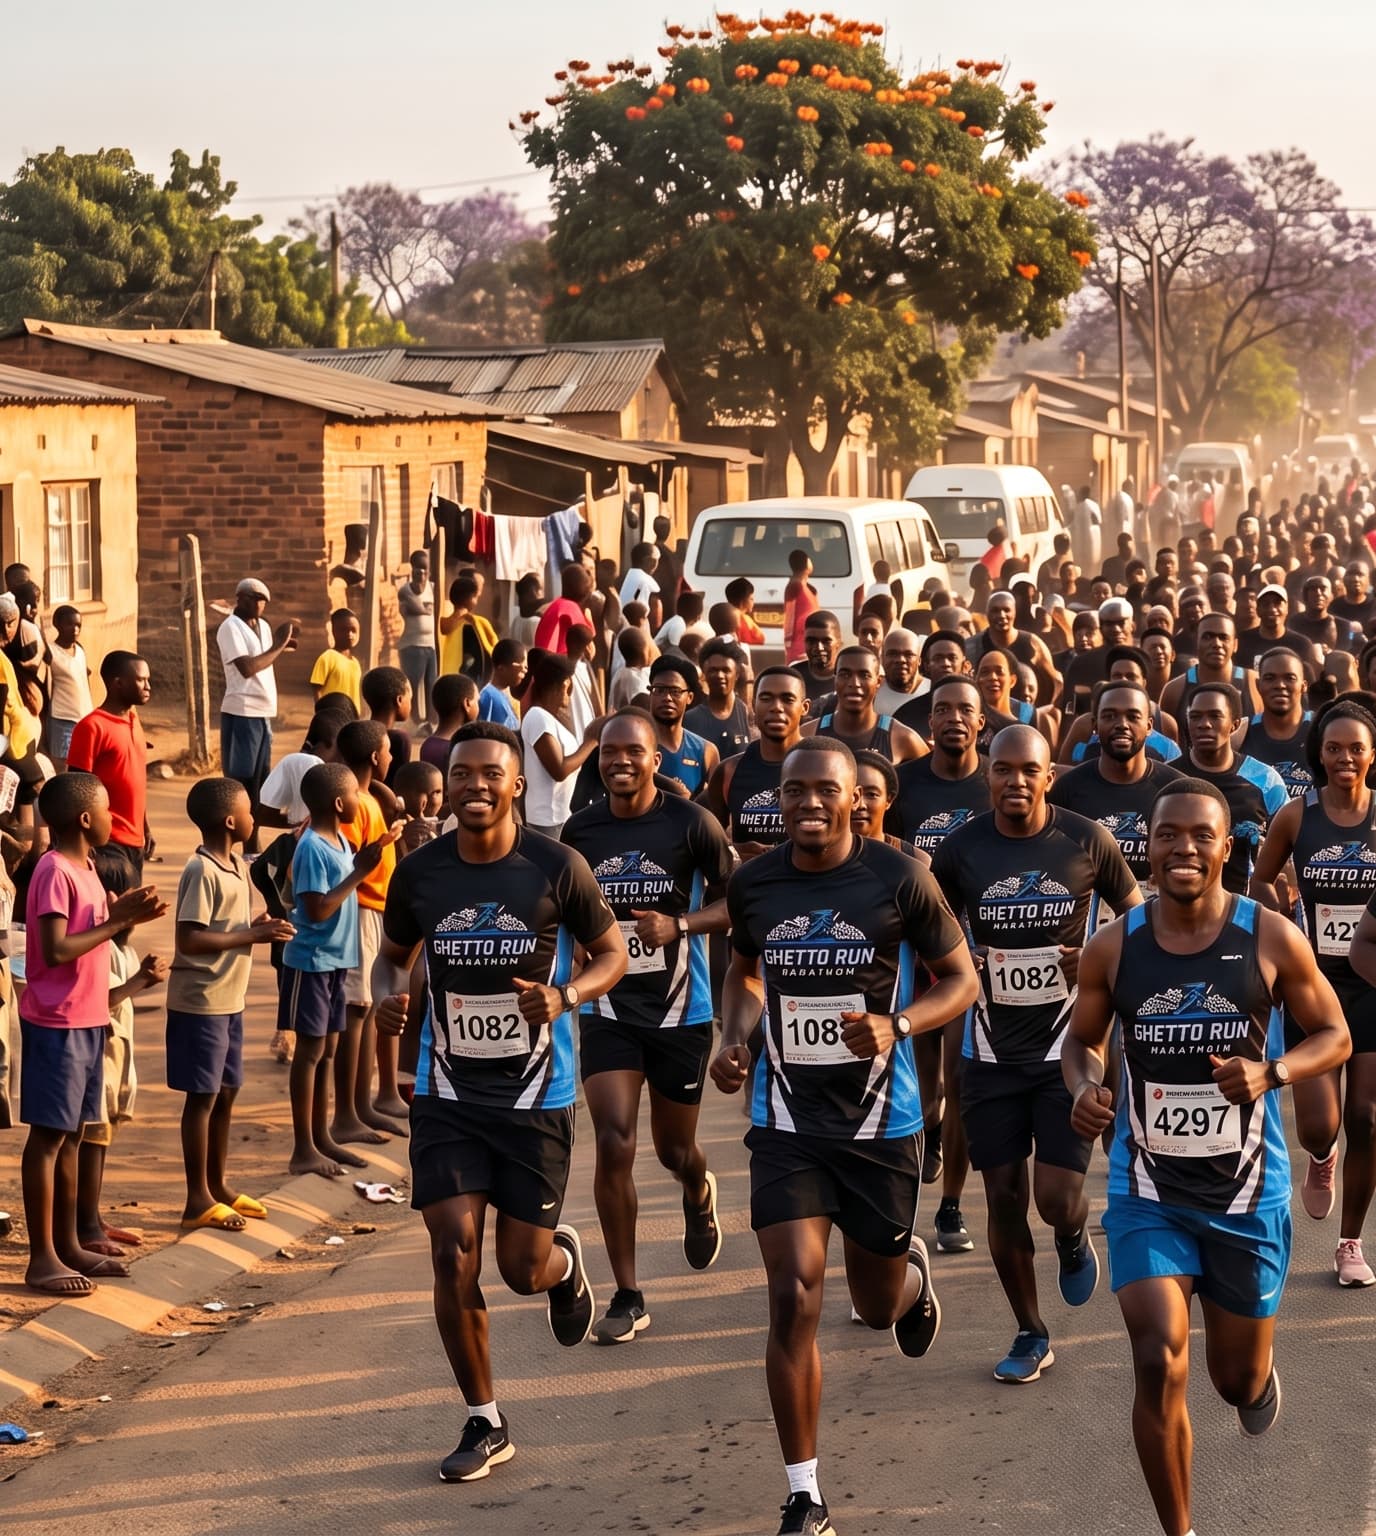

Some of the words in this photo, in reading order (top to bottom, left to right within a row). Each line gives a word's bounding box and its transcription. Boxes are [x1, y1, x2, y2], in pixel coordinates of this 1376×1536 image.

[1303, 866, 1358, 881] GHETTO
[643, 879, 674, 894] RUN
[979, 903, 1038, 921] GHETTO
[1042, 900, 1076, 917] RUN
[433, 939, 495, 956] GHETTO
[500, 937, 537, 955] RUN
[764, 949, 830, 966] GHETTO
[834, 947, 876, 965] RUN
[995, 964, 1059, 991] 1082
[453, 1013, 521, 1041] 1082
[787, 1018, 842, 1046] 108
[1134, 1024, 1203, 1042] GHETTO
[1209, 1020, 1250, 1040] RUN
[1153, 1105, 1231, 1137] 4297
